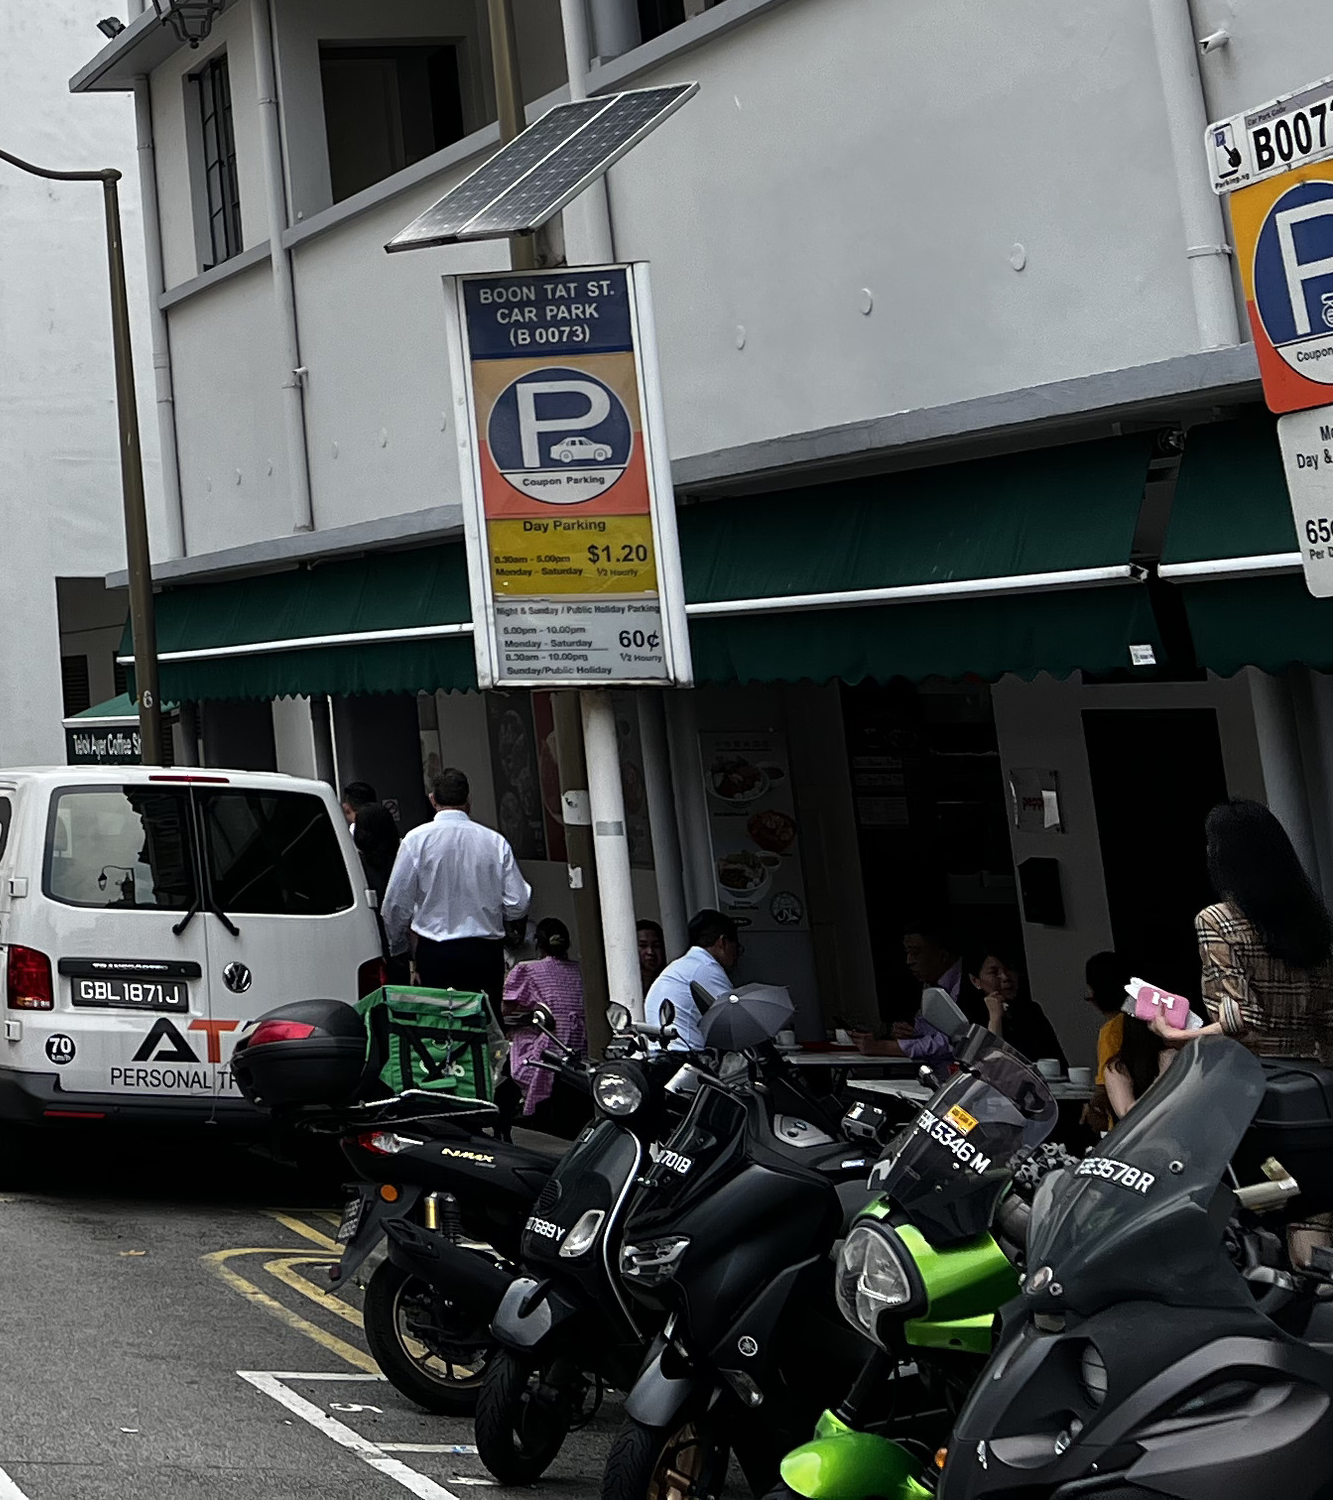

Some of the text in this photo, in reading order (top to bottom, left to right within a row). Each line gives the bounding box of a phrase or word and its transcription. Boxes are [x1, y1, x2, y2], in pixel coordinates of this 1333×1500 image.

[1252, 99, 1333, 171] B007
[479, 280, 615, 304] BOON TAT ST.
[496, 303, 599, 324] CAR PARK
[1296, 453, 1319, 471] Day
[522, 475, 605, 487] Coupon Parking
[523, 519, 606, 533] Day Parking
[1305, 518, 1333, 544] 65
[586, 543, 648, 565] $1.20
[1309, 549, 1325, 560] Per
[495, 568, 532, 577] Monday
[541, 566, 583, 577] Saturday
[496, 606, 519, 616] Night
[528, 605, 559, 616] Sunday
[566, 605, 593, 614] Public
[594, 604, 626, 615] Holiday
[627, 604, 661, 615] Parking
[546, 626, 586, 635] 10.00pm
[504, 640, 542, 649] Monday
[550, 639, 593, 649] Saturday
[618, 630, 661, 651] 60¢
[576, 666, 612, 676] Holiday
[142, 690, 154, 709] 6
[91, 733, 107, 761] Ayer
[107, 733, 132, 755] Coffee
[49, 1037, 72, 1054] 70
[110, 1066, 213, 1090] PERSONAL
